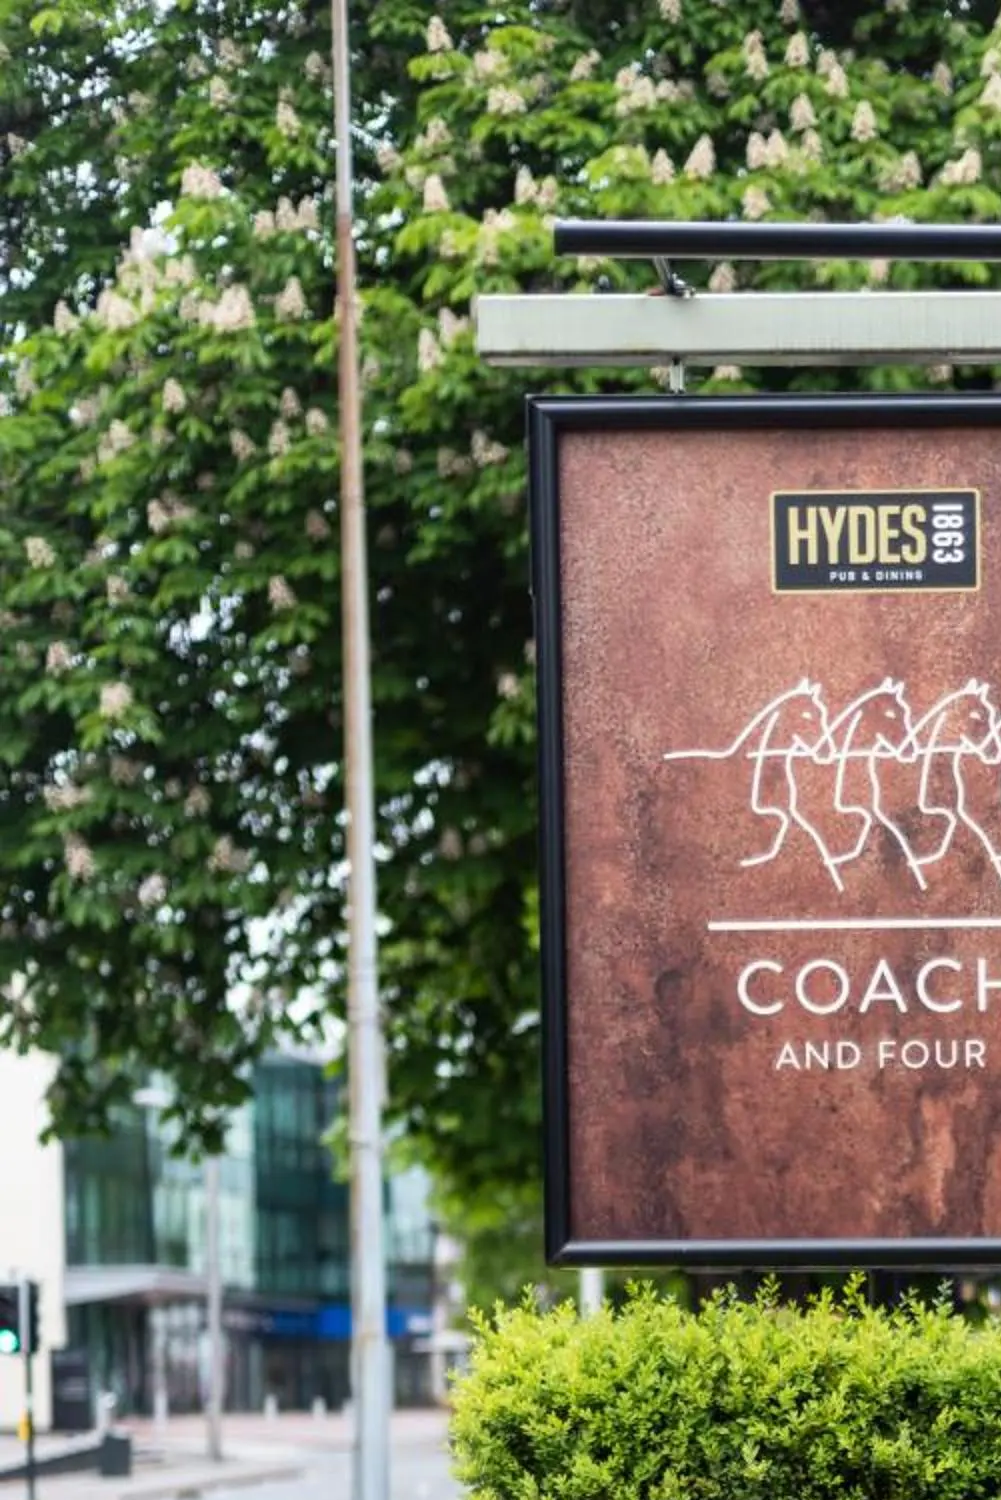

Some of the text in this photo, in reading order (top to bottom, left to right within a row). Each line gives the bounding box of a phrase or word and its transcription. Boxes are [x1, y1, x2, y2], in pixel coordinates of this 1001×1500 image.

[788, 504, 926, 565] HYDES
[932, 503, 965, 564] 1863
[829, 570, 923, 582] PUB & DINING
[776, 1040, 987, 1070] AND FOUR
